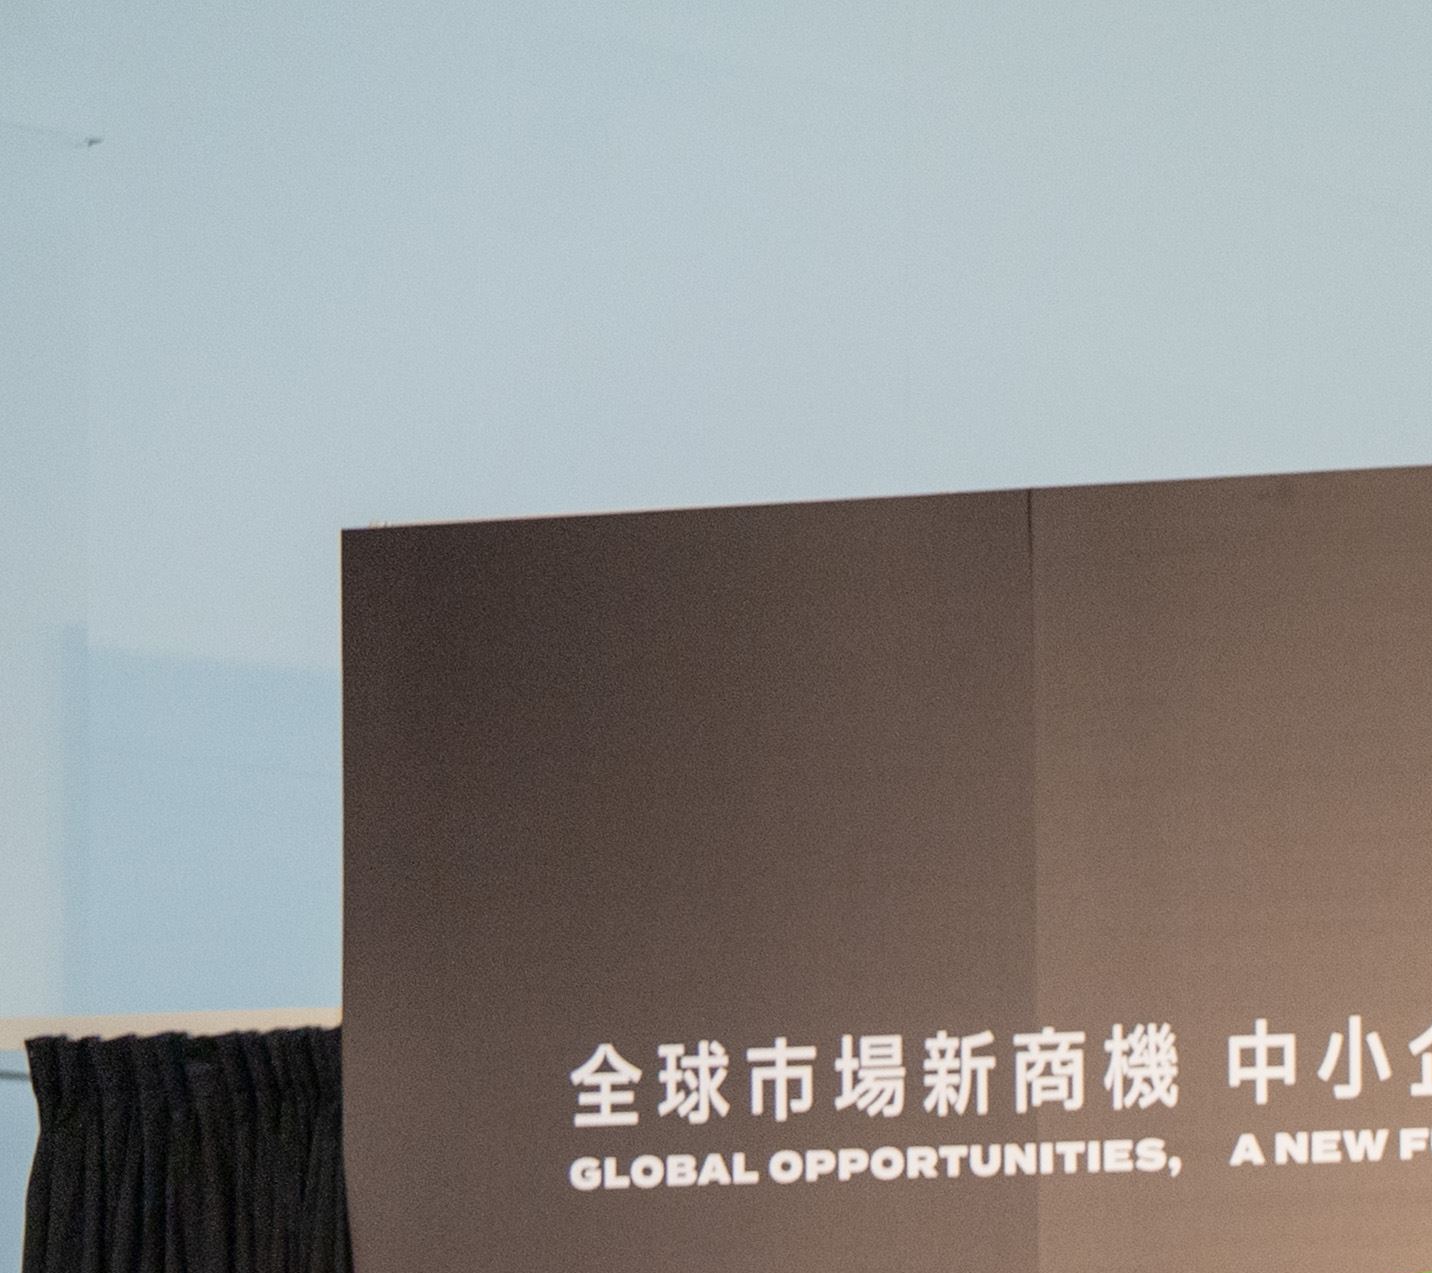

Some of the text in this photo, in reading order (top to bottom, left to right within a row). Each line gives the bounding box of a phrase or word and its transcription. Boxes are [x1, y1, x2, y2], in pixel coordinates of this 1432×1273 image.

[569, 1022, 1180, 1128] 全球市場新商機
[569, 1152, 759, 1190] GLOBAL
[768, 1137, 1182, 1184] OPPORTUNITIES,
[1229, 1132, 1266, 1166] A
[1273, 1128, 1389, 1164] NEW
